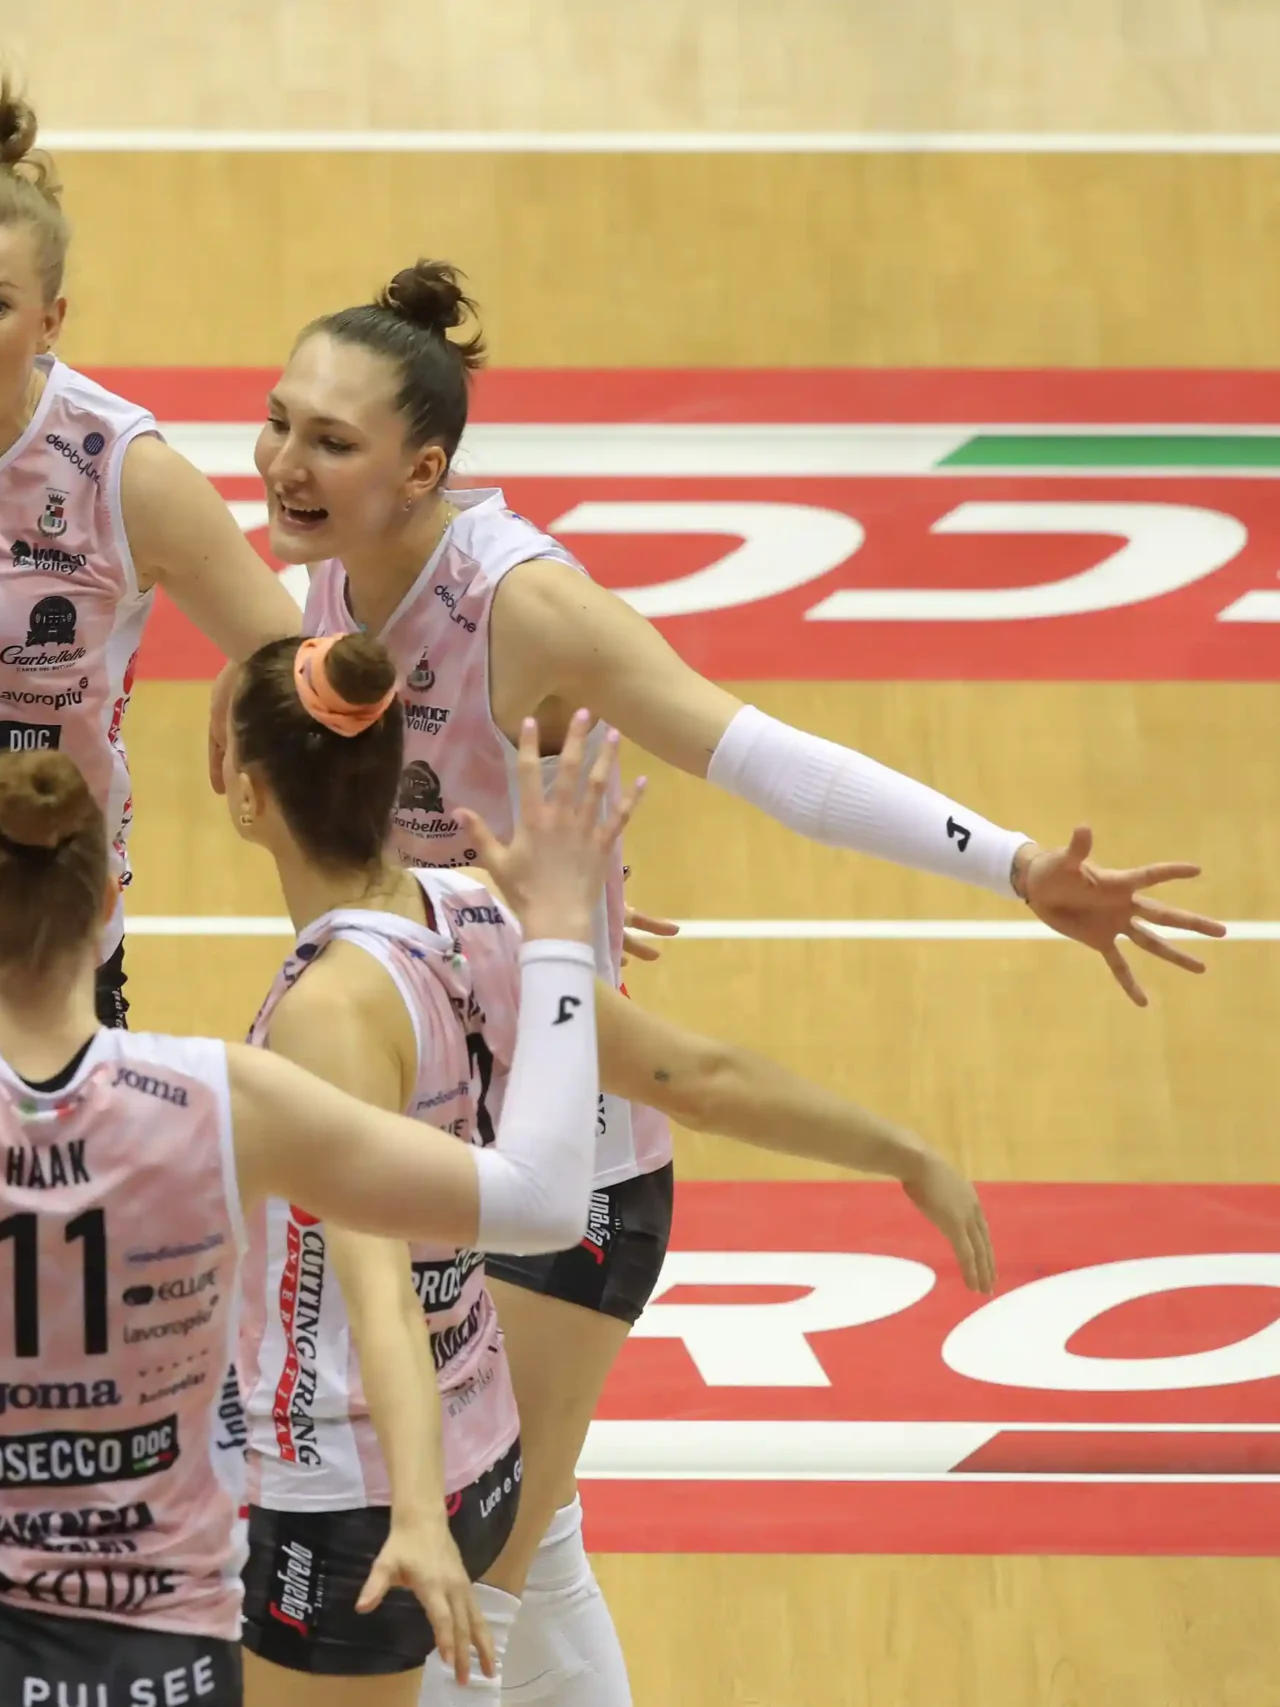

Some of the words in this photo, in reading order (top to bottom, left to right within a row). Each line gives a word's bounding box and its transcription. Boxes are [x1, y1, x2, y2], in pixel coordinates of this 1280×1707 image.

[9, 728, 50, 751] DOC
[406, 717, 442, 736] Volley
[5, 1138, 90, 1190] HAAK
[132, 1425, 173, 1459] DOC
